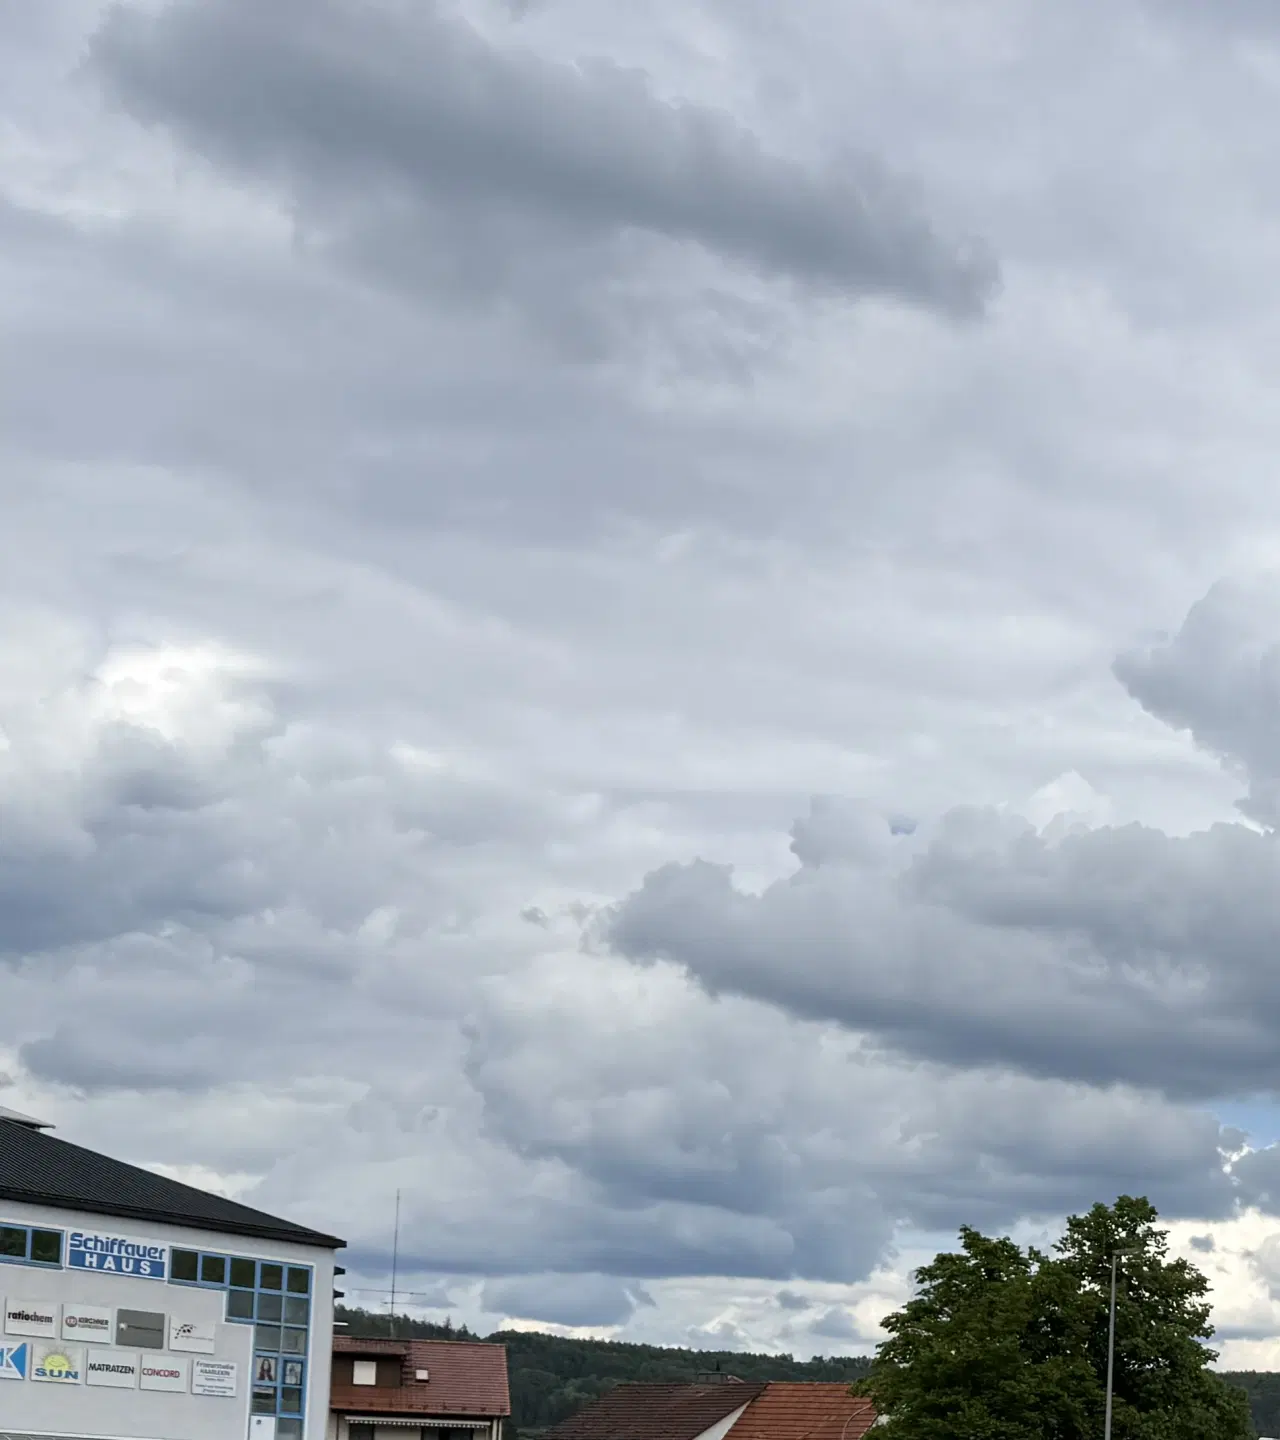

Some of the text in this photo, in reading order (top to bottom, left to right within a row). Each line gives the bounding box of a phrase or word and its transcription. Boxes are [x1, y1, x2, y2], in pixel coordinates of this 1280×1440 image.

[69, 1232, 166, 1260] Schiffauer
[84, 1252, 152, 1275] HAUS
[7, 1310, 53, 1323] ratiochem
[34, 1367, 79, 1380] SUN
[88, 1362, 135, 1375] MATRATZEN
[141, 1367, 180, 1379] CONCORD
